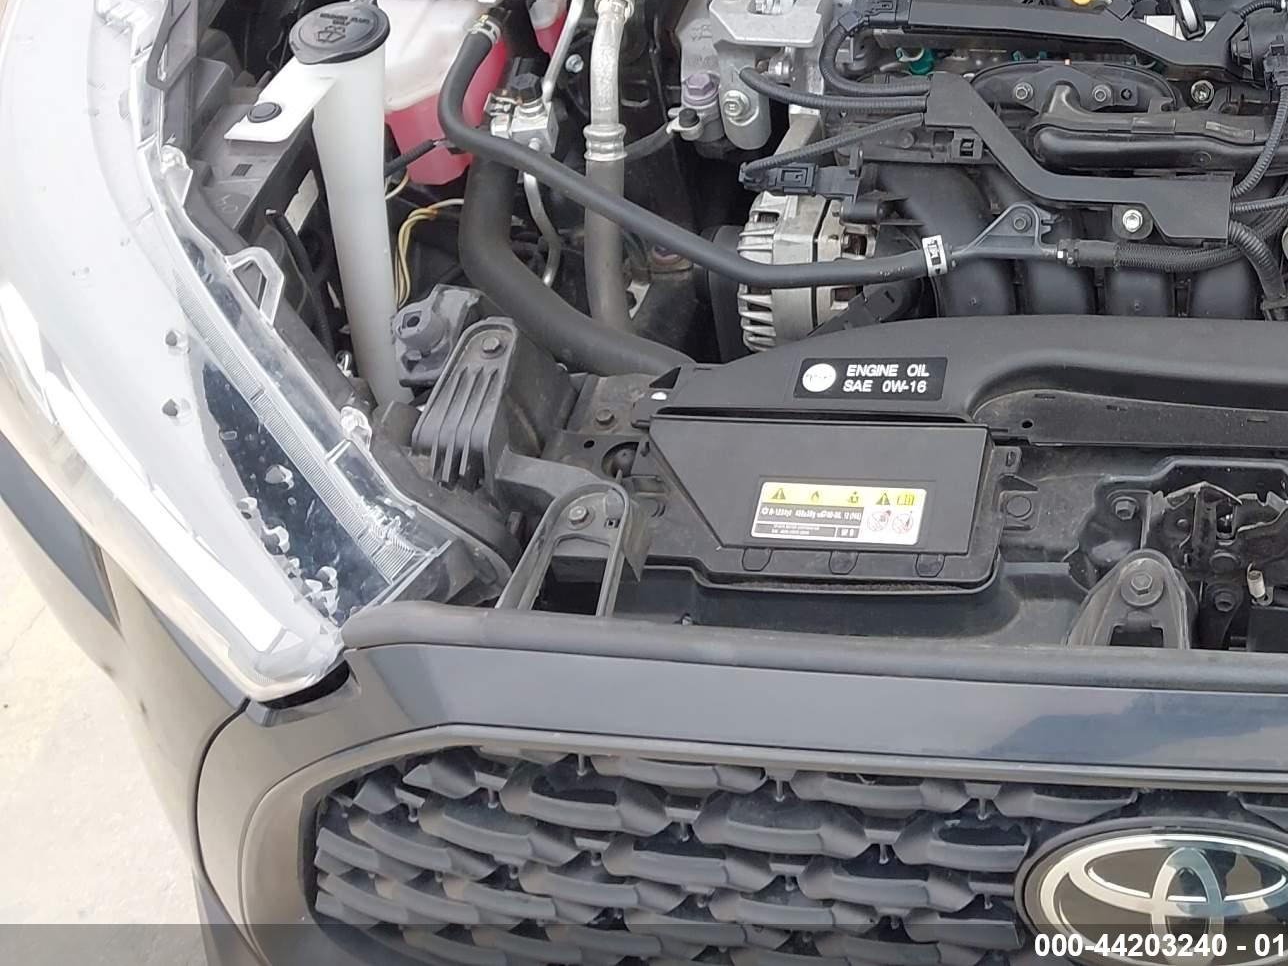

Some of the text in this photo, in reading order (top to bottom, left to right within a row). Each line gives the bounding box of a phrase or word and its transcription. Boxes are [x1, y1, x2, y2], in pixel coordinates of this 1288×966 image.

[846, 364, 930, 377] ENGINE OIL
[843, 380, 927, 394] SAE 0W-16
